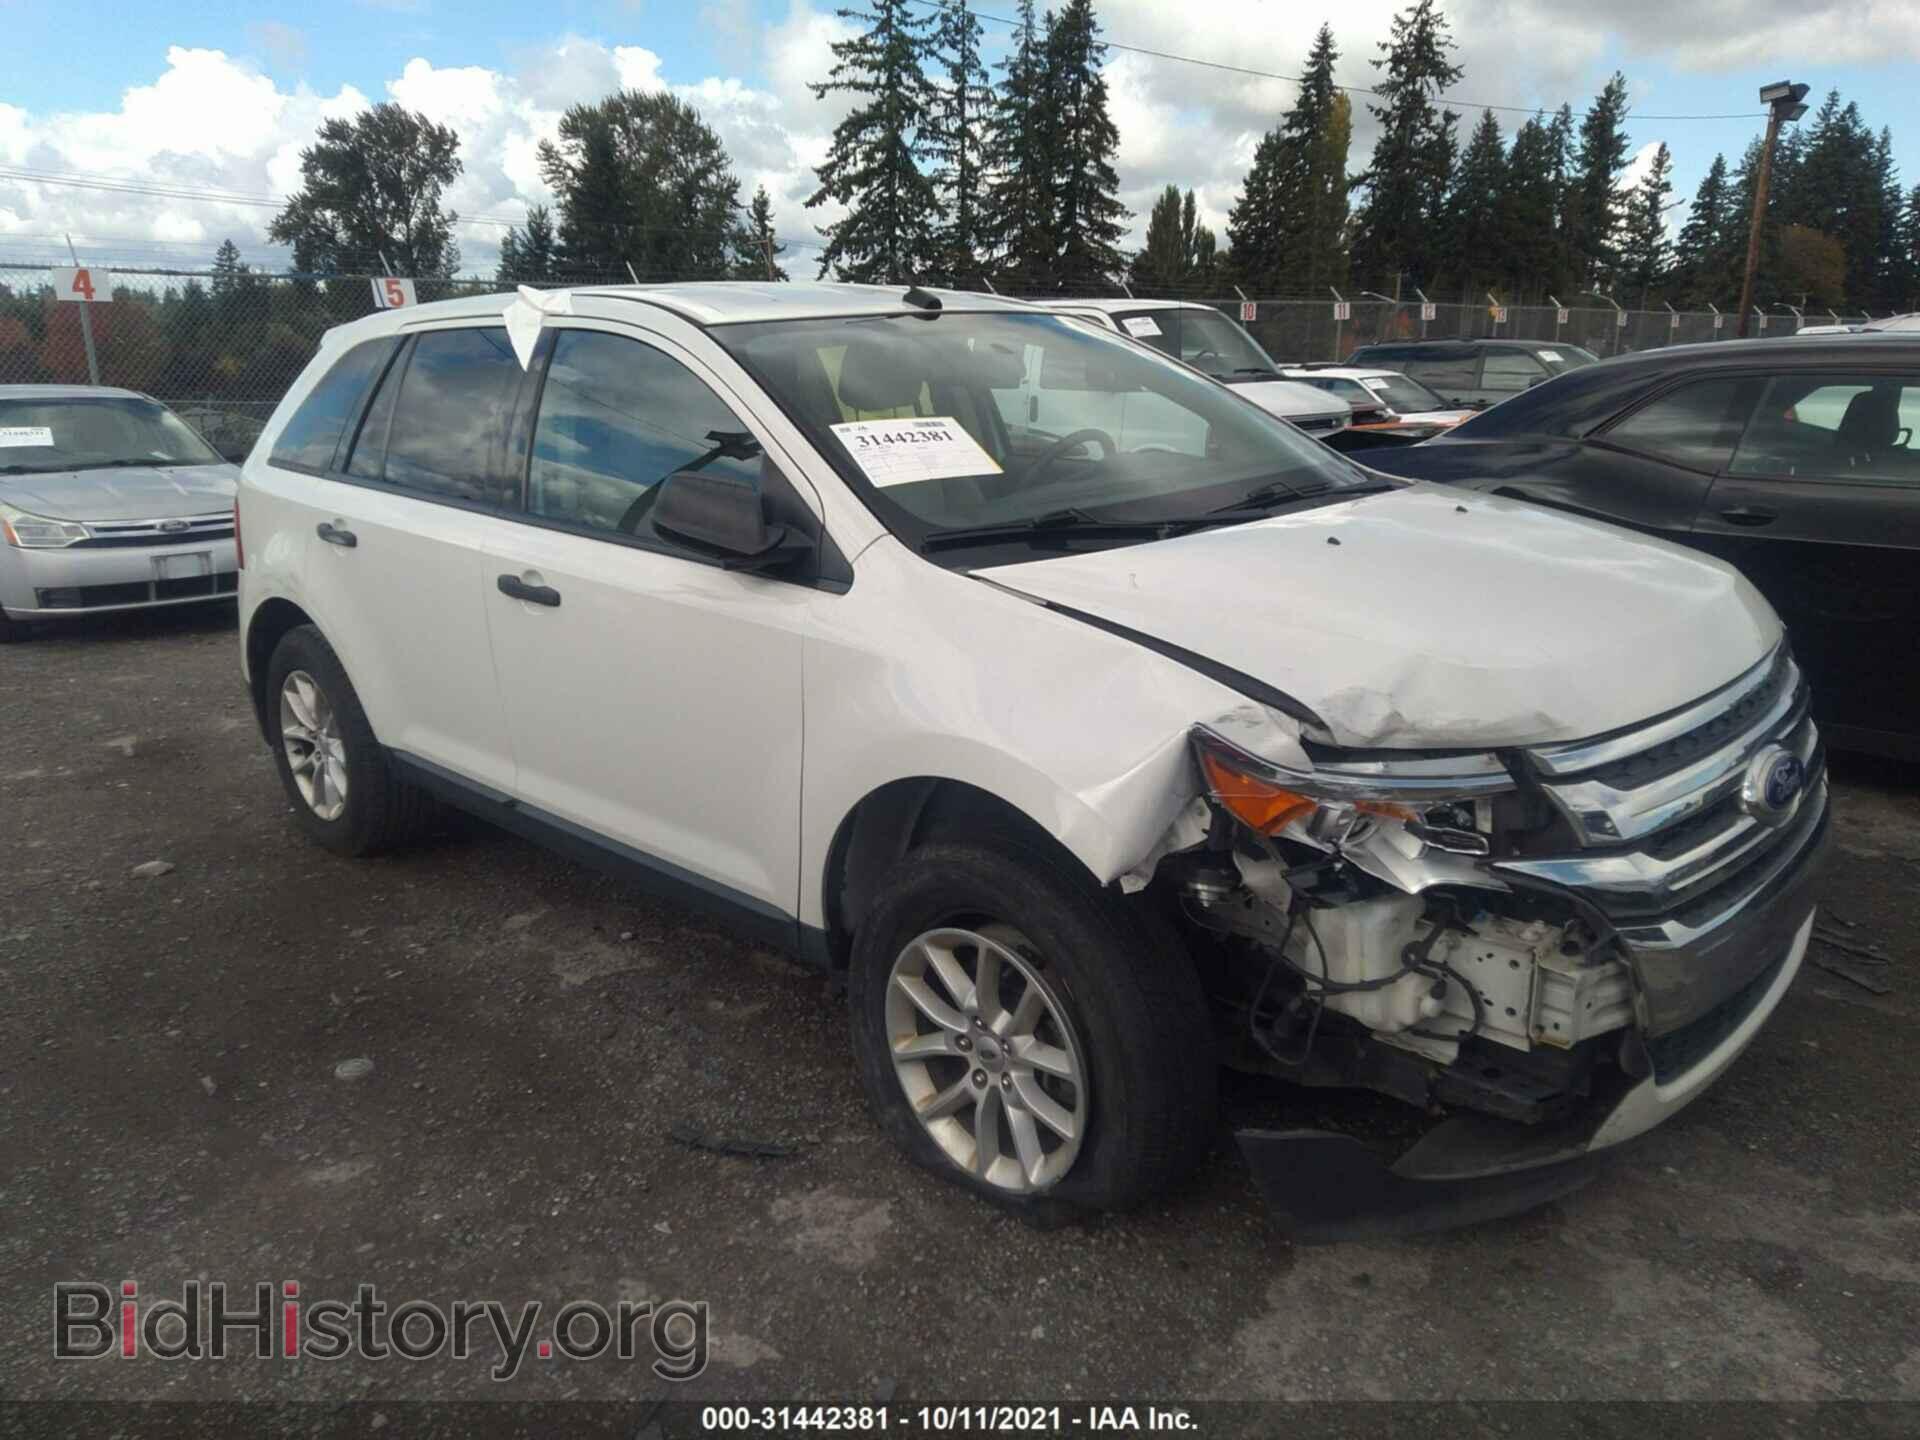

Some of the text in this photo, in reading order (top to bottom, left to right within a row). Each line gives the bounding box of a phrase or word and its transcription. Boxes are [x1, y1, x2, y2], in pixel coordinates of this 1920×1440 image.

[72, 269, 96, 302] 4
[385, 278, 405, 307] 5
[1243, 303, 1254, 319] 10
[1337, 303, 1347, 319] 11
[855, 430, 953, 448] 31442381
